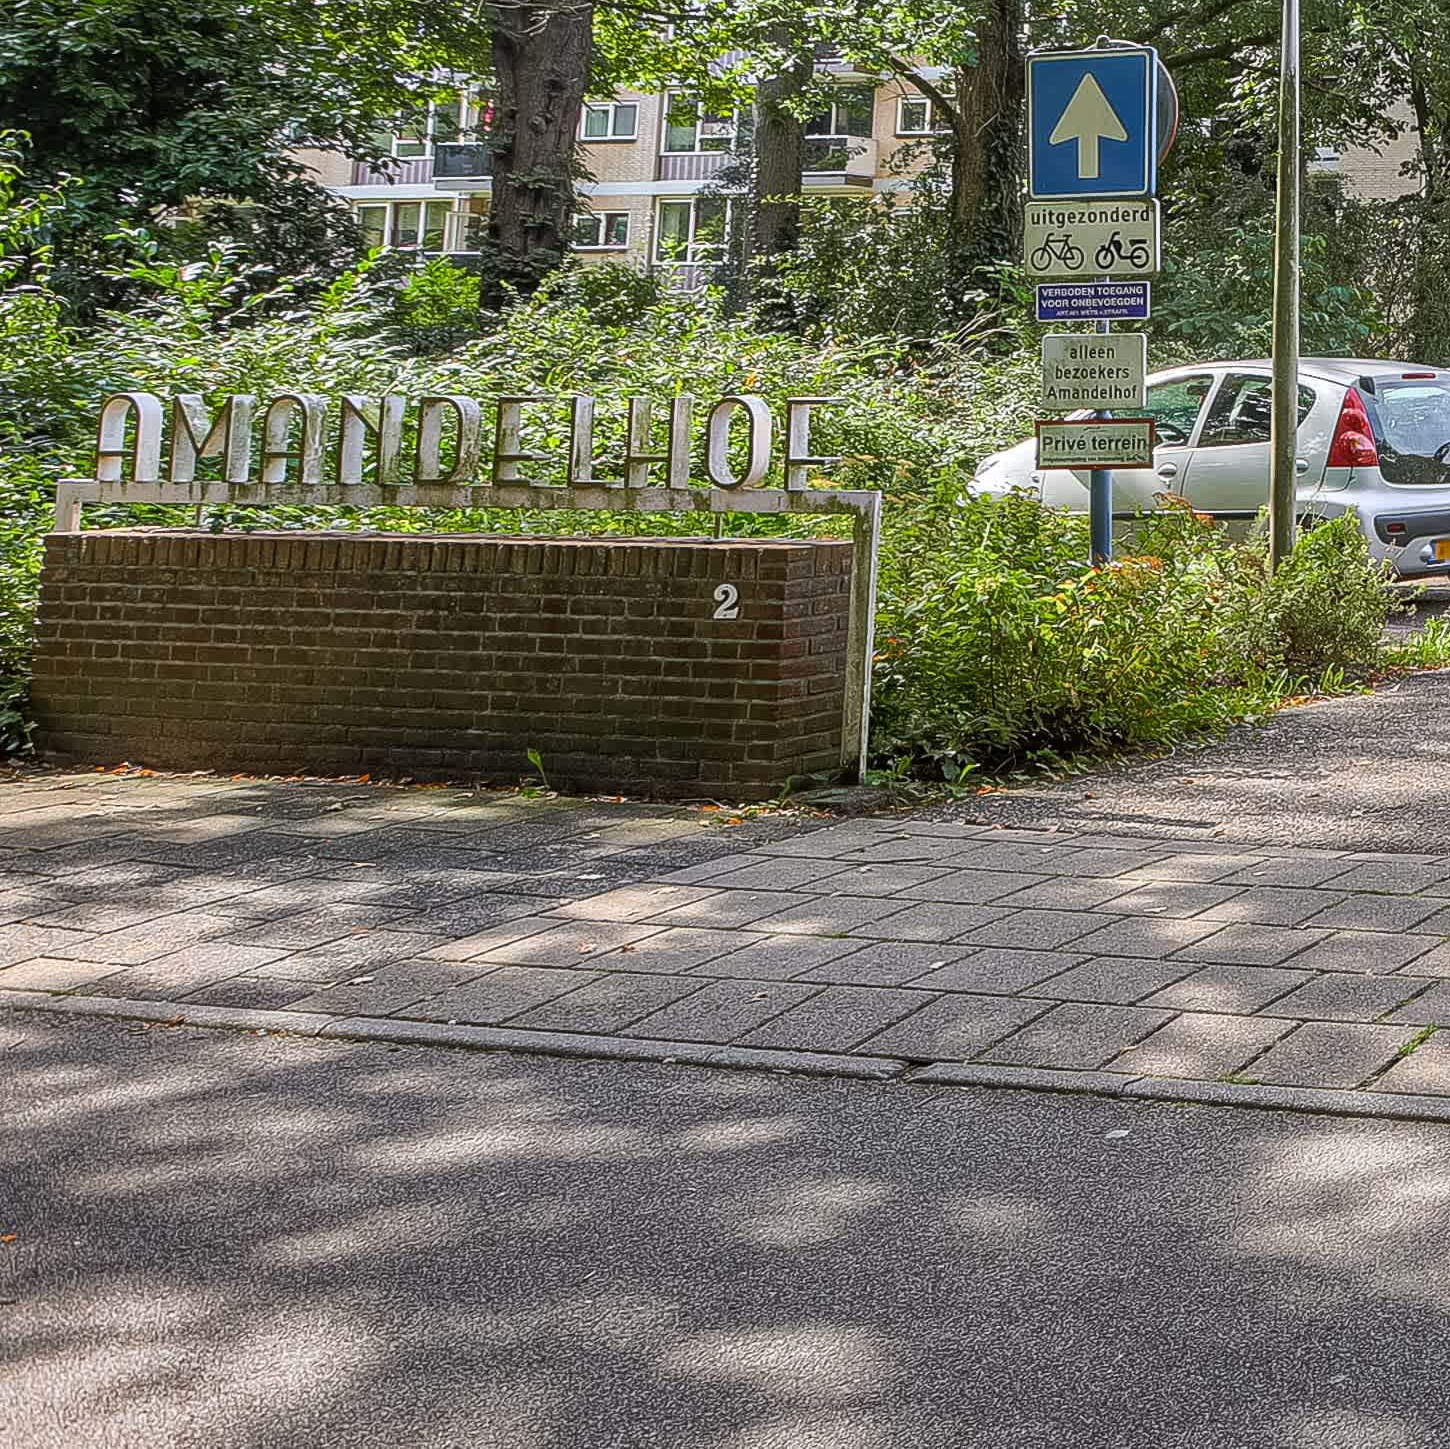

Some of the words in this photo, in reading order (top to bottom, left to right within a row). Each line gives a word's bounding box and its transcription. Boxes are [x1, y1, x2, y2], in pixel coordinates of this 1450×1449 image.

[1031, 206, 1150, 229] uitgezonderd
[1041, 287, 1095, 297] VERBODEN
[1097, 286, 1144, 296] TOEGANG
[1041, 299, 1069, 308] VOOR
[1071, 297, 1144, 307] ONBEVOEGDEN
[1069, 345, 1115, 359] alleen
[1055, 364, 1130, 380] bezoekers
[1047, 385, 1137, 400] Amandelhof
[95, 392, 845, 493] AMANDELHOF
[1042, 434, 1086, 451] Privé
[1091, 434, 1147, 451] terrein
[713, 583, 739, 619] 2
